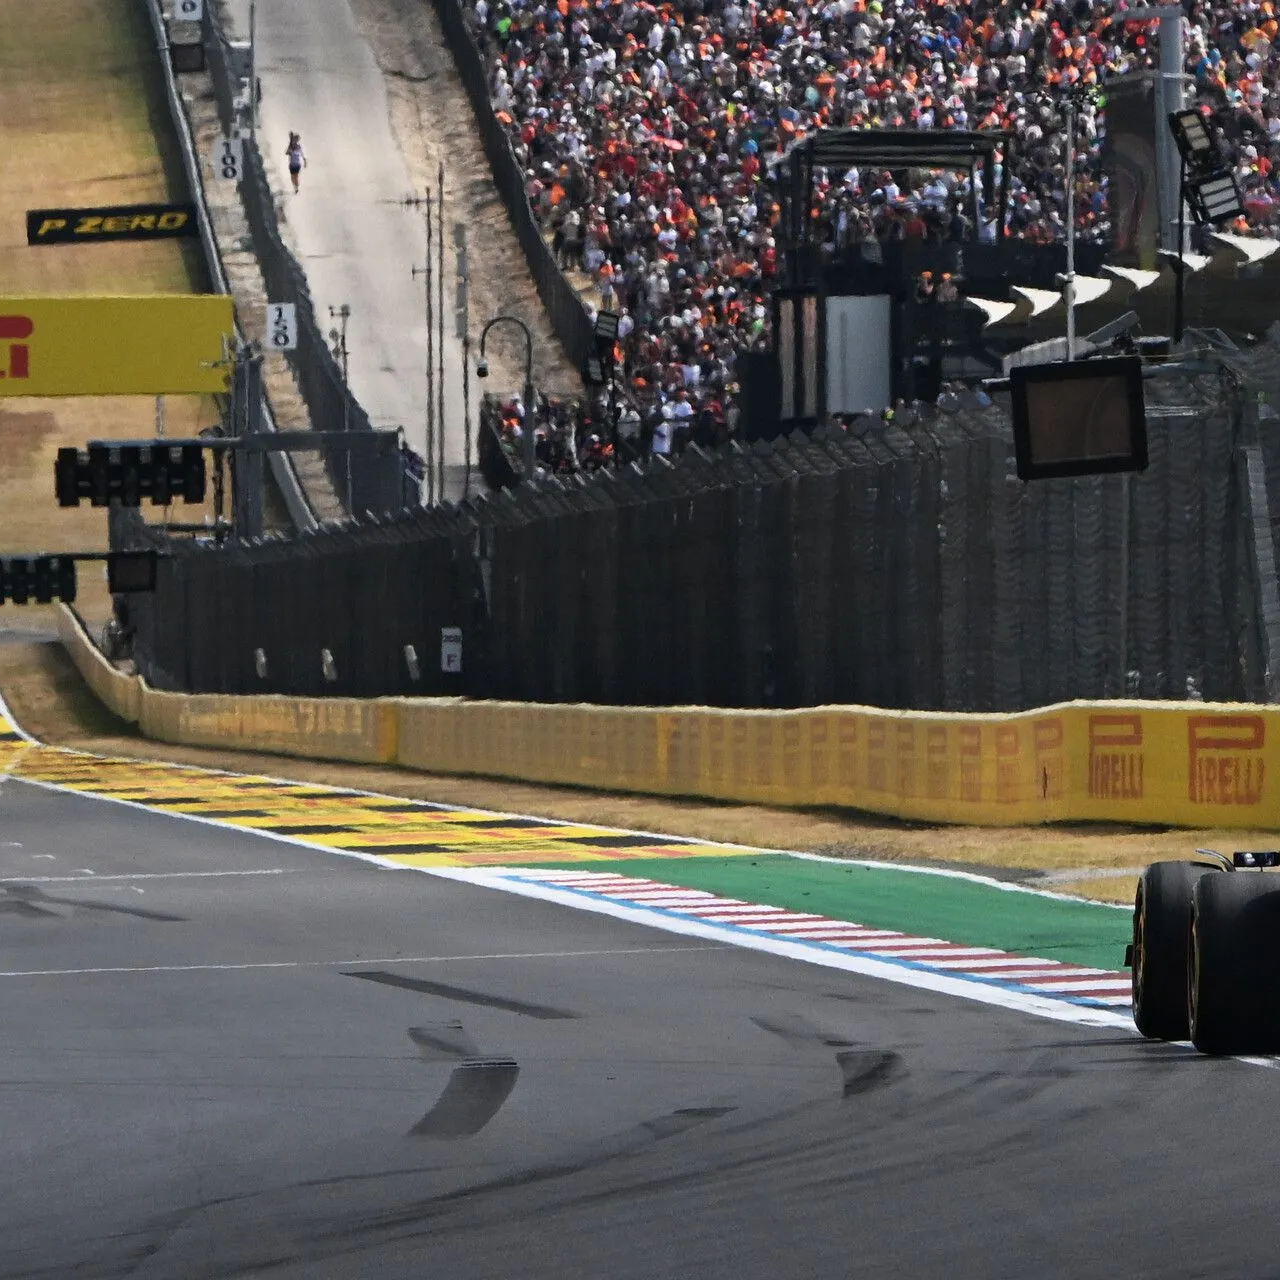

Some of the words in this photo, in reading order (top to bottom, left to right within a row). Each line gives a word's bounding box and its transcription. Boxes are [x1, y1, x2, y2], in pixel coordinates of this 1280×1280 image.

[37, 219, 66, 237] P
[73, 211, 188, 234] ZERO
[1088, 715, 1144, 798] PIRELLI
[1187, 715, 1265, 804] PIRELLI
